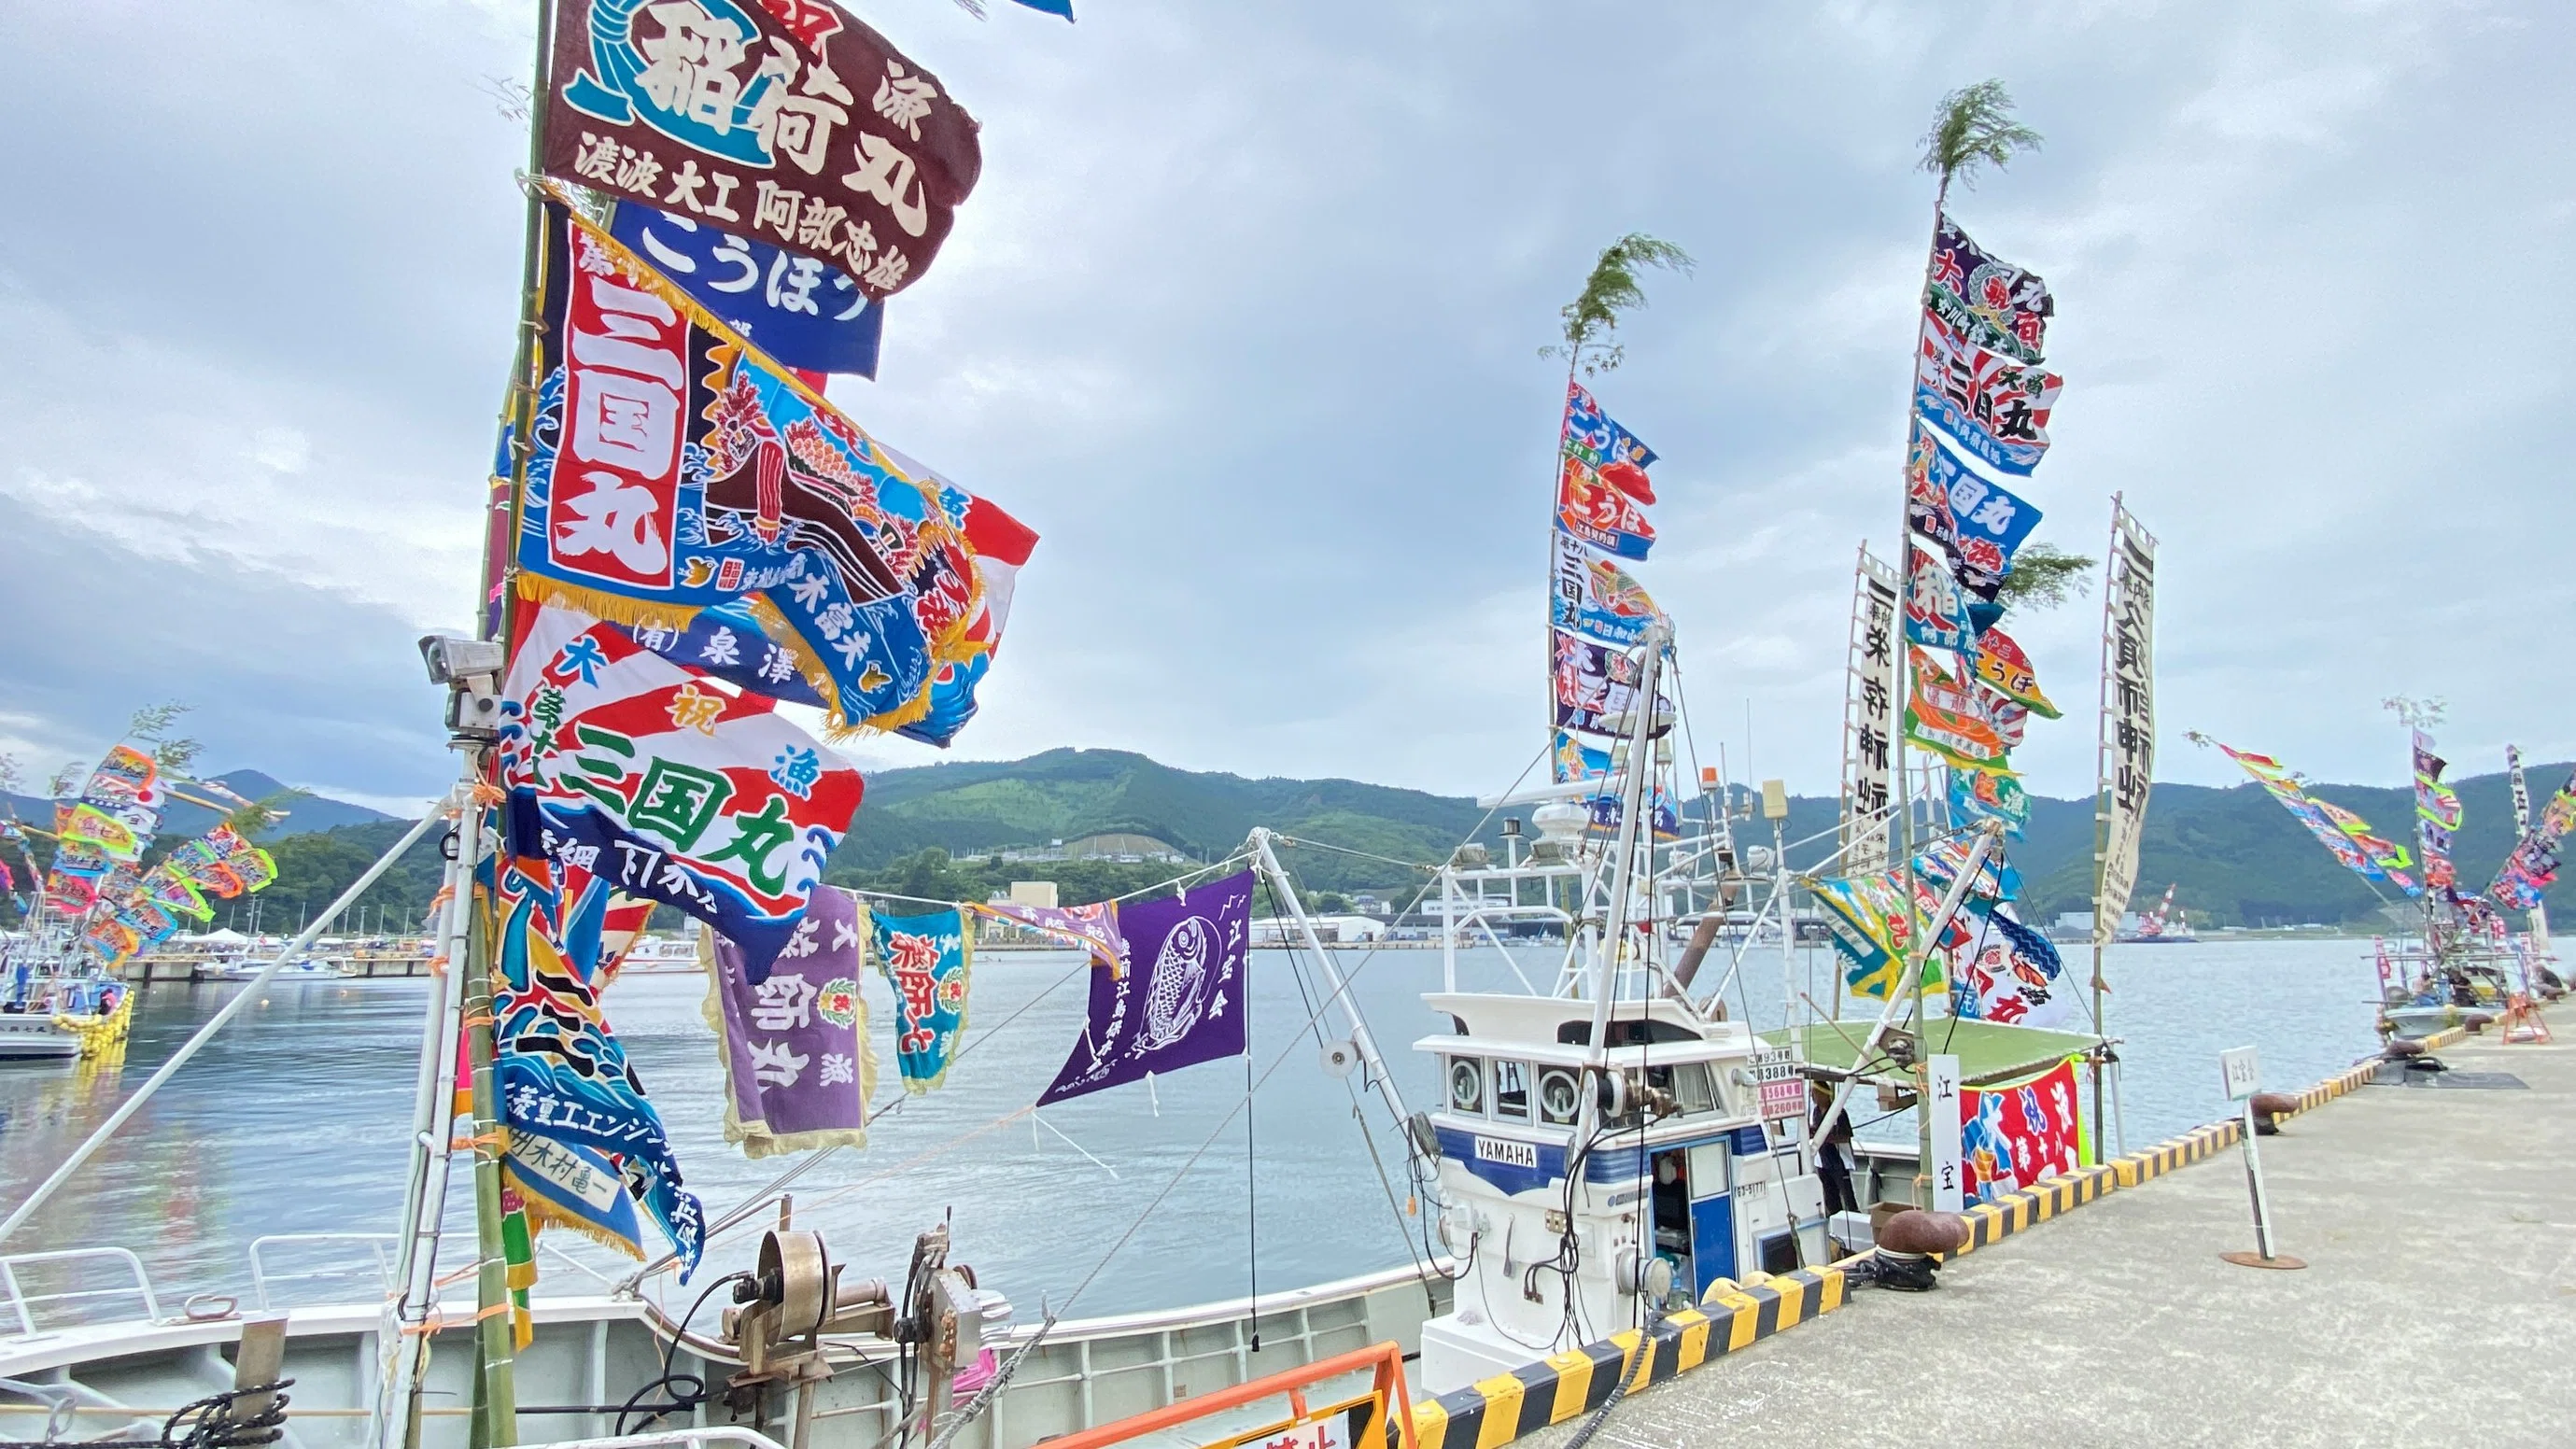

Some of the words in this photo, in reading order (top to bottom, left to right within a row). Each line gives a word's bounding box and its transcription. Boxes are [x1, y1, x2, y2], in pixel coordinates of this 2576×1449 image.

[635, 1, 927, 237] 稲荷丸
[872, 59, 937, 141] 漁
[575, 131, 664, 197] 渡波
[555, 274, 682, 575] 三国丸
[1560, 550, 1584, 629] 三国丸
[666, 684, 728, 736] 祝
[560, 722, 795, 895] 三国丸
[769, 742, 823, 800] 漁
[1478, 1140, 1534, 1167] YAMAHA
